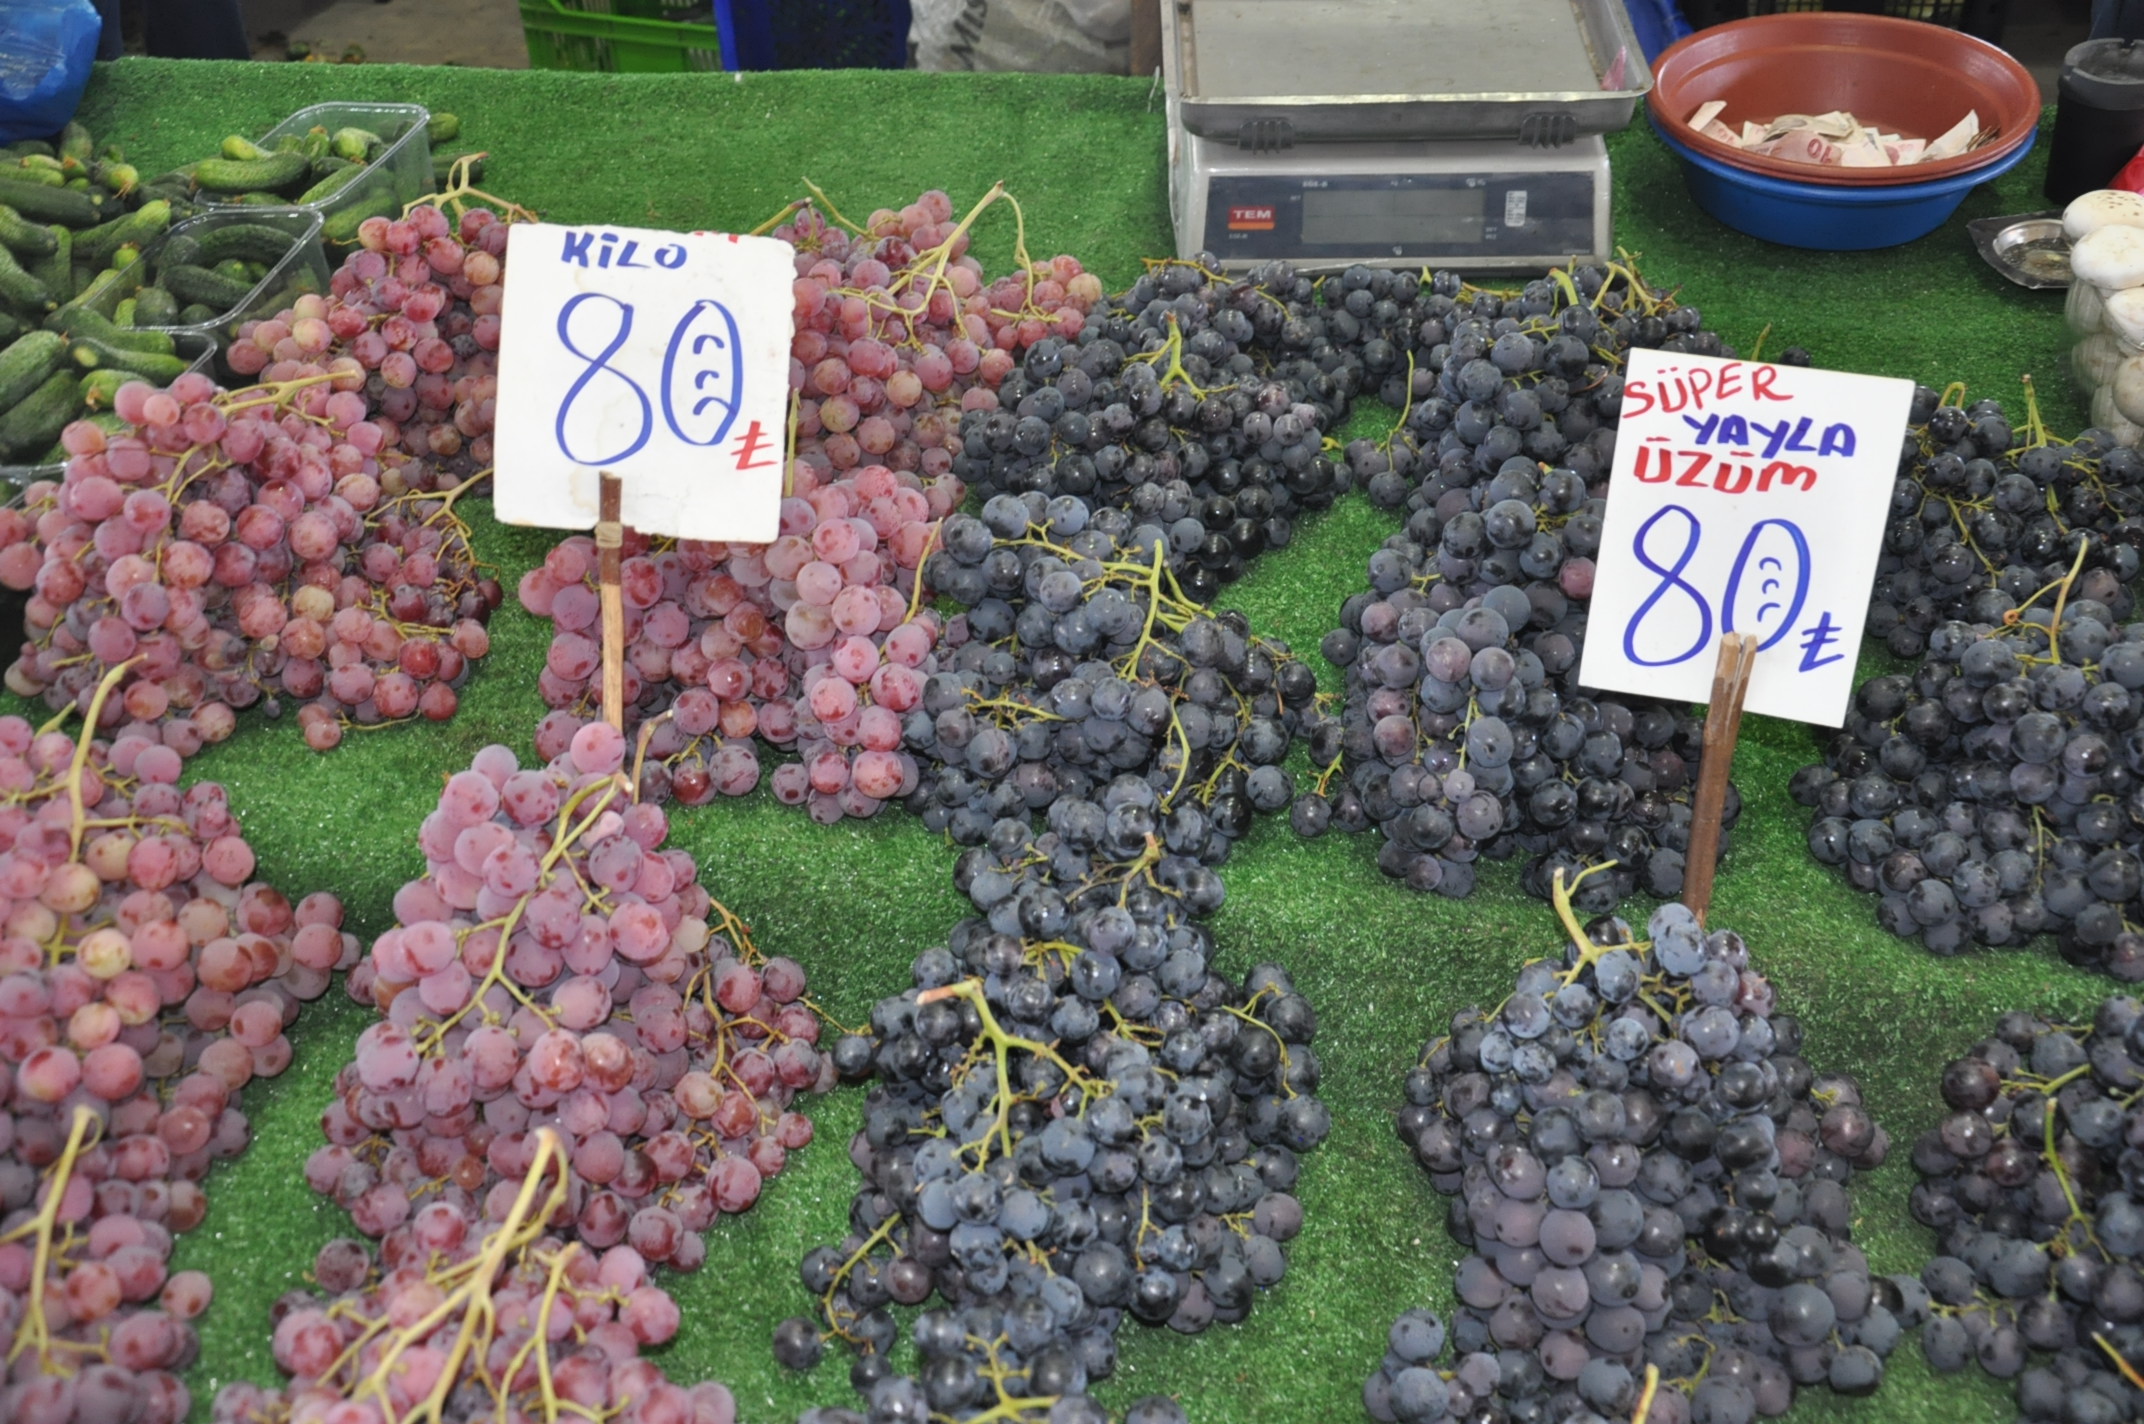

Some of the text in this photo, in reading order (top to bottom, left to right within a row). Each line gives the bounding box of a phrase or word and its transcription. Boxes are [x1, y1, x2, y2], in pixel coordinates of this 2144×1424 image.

[1233, 209, 1272, 219] TEM
[1621, 362, 1794, 419] SÜPER
[1682, 413, 1856, 459] YAYLA
